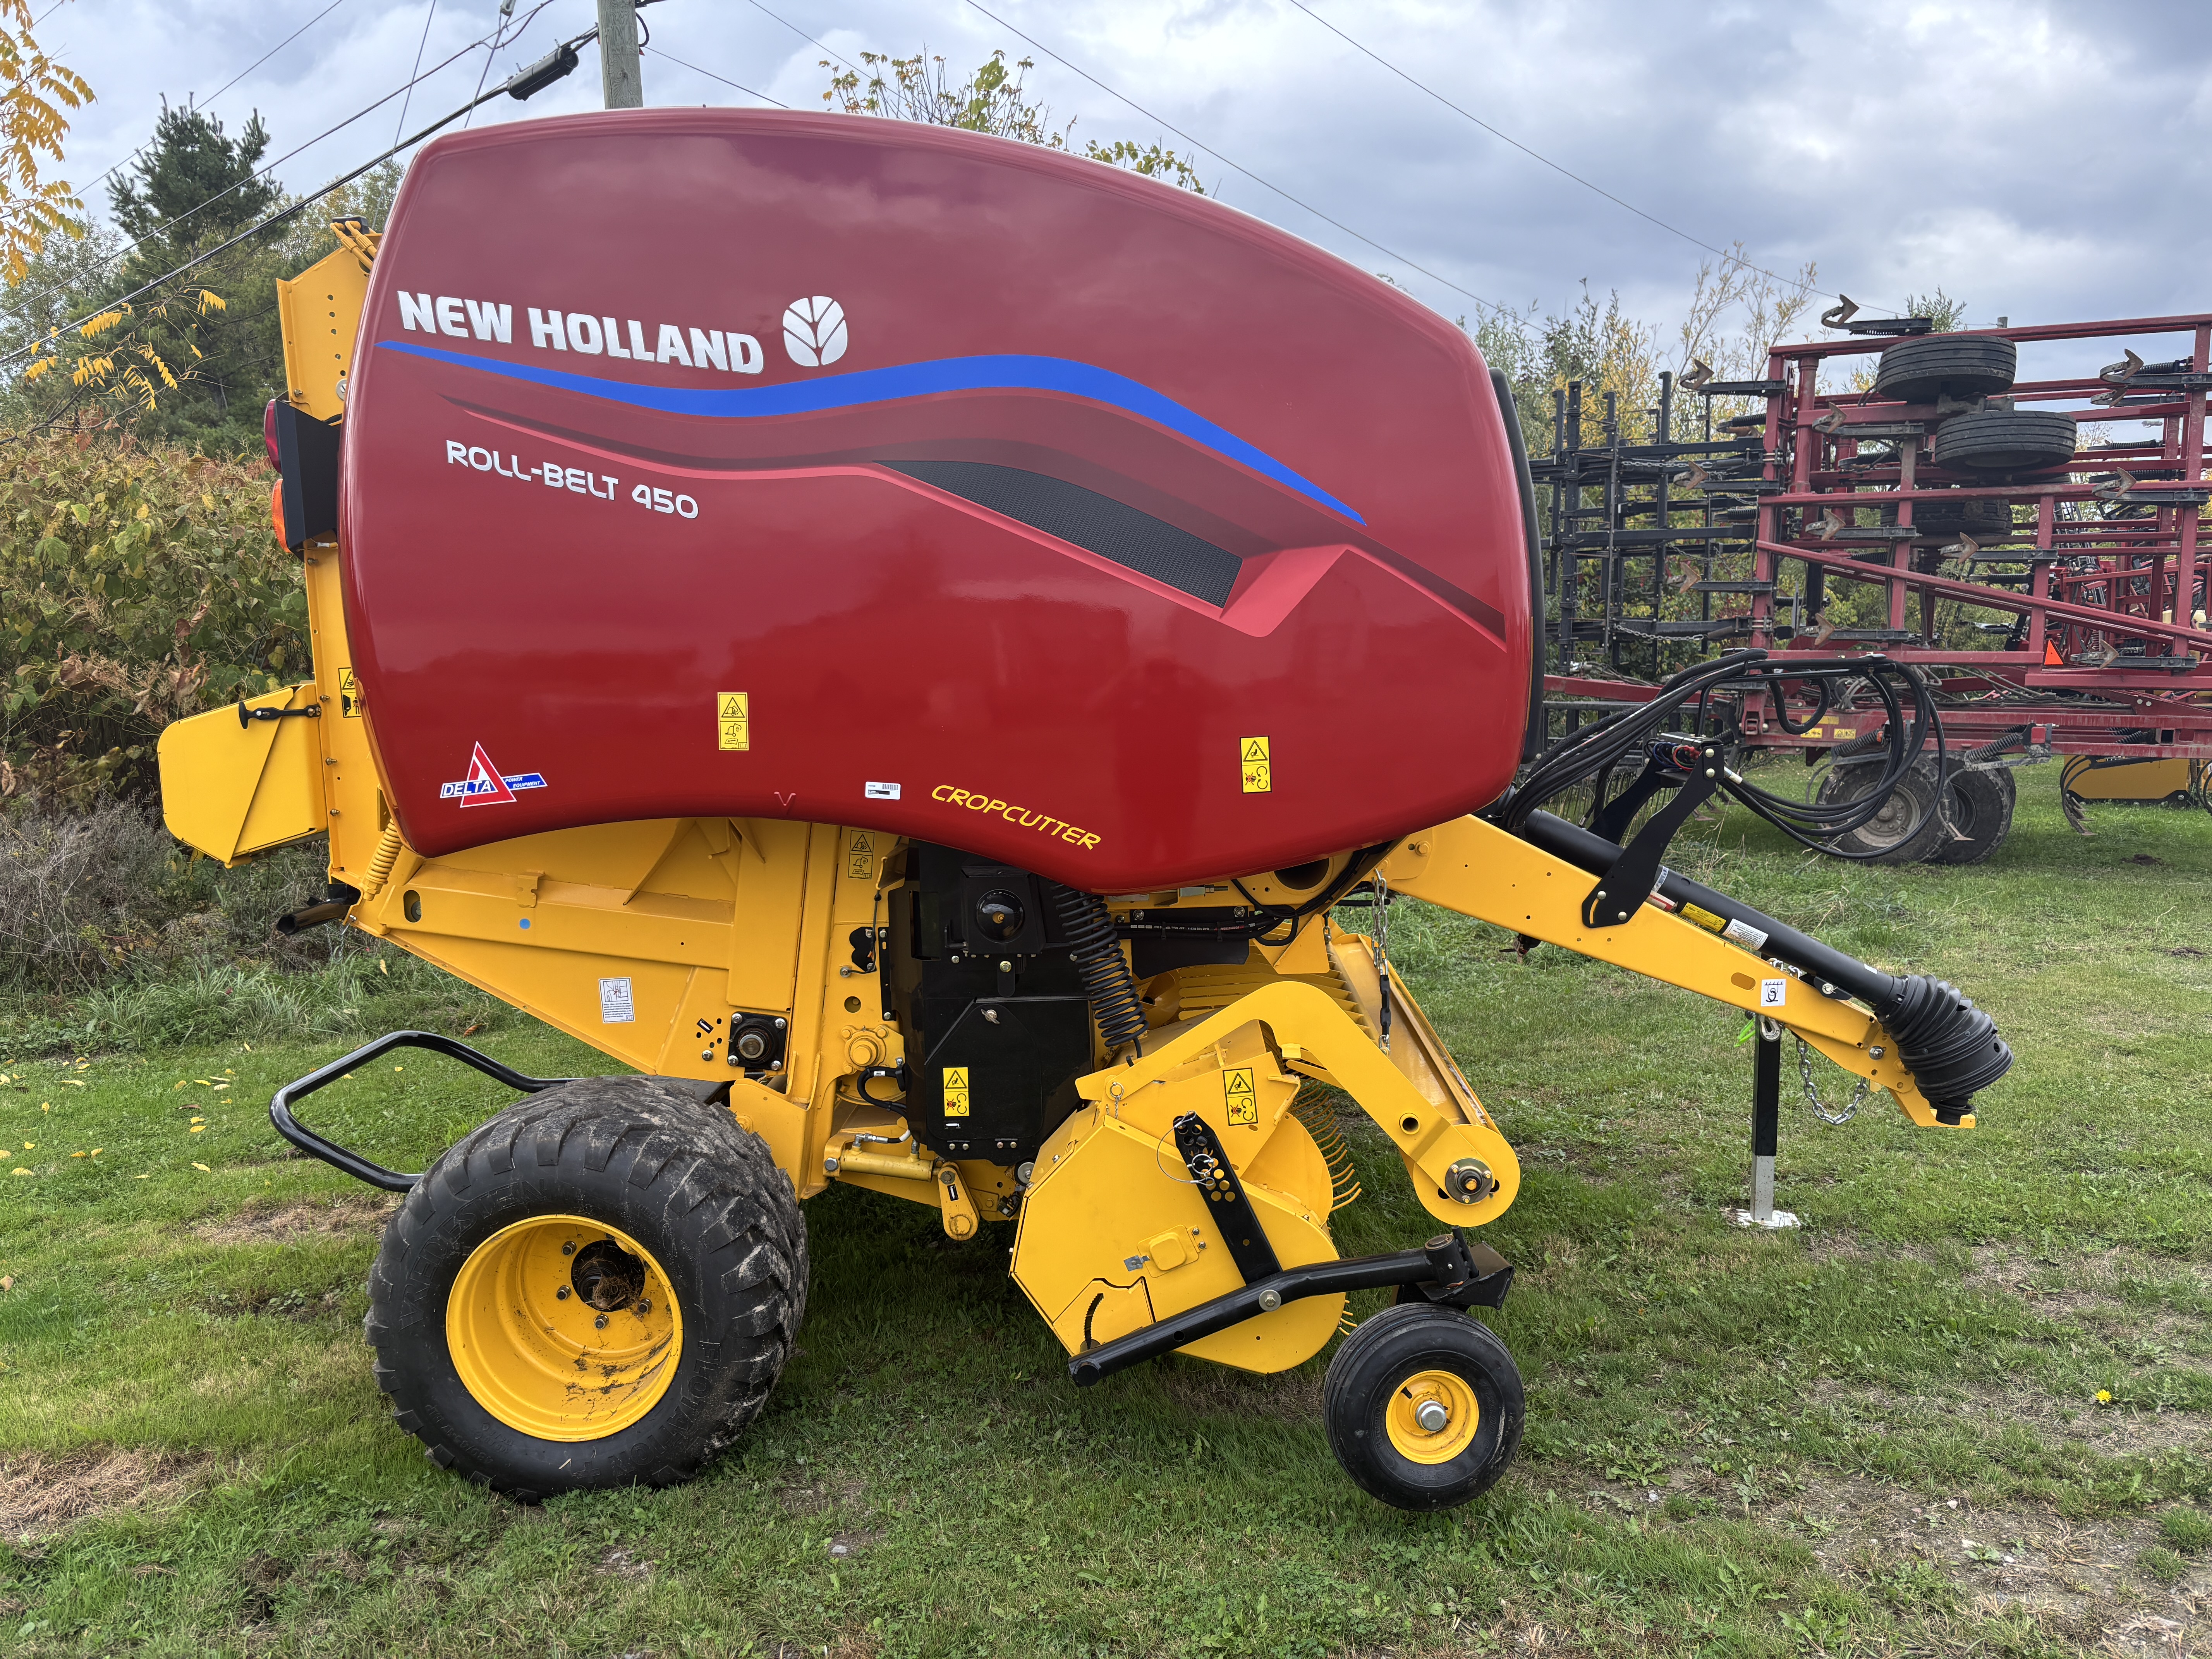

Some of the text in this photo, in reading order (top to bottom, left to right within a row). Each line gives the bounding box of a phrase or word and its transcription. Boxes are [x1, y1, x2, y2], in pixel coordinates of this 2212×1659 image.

[397, 290, 765, 375] NEW HOLLAND
[446, 440, 699, 519] ROLL-BELT 450
[443, 780, 491, 796] DELTA
[512, 780, 541, 788] EQUIPMENT
[931, 785, 1101, 850] CROPCUTTER
